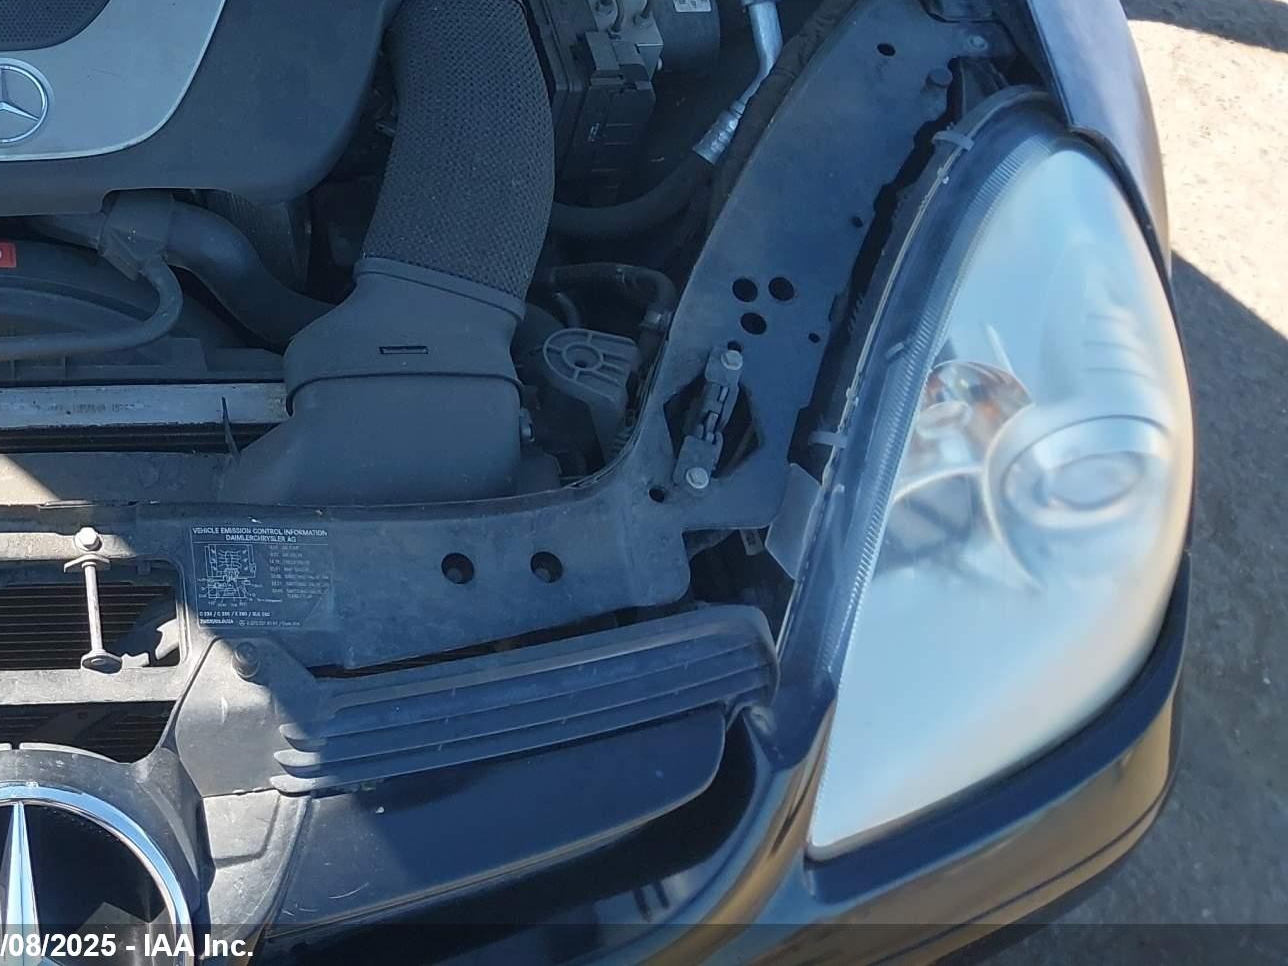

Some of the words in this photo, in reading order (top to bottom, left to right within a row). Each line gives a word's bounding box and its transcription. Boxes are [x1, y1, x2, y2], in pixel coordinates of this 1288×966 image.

[220, 527, 252, 535] EMISSION
[253, 528, 283, 536] CONTROL
[284, 529, 328, 537] INFORMATION
